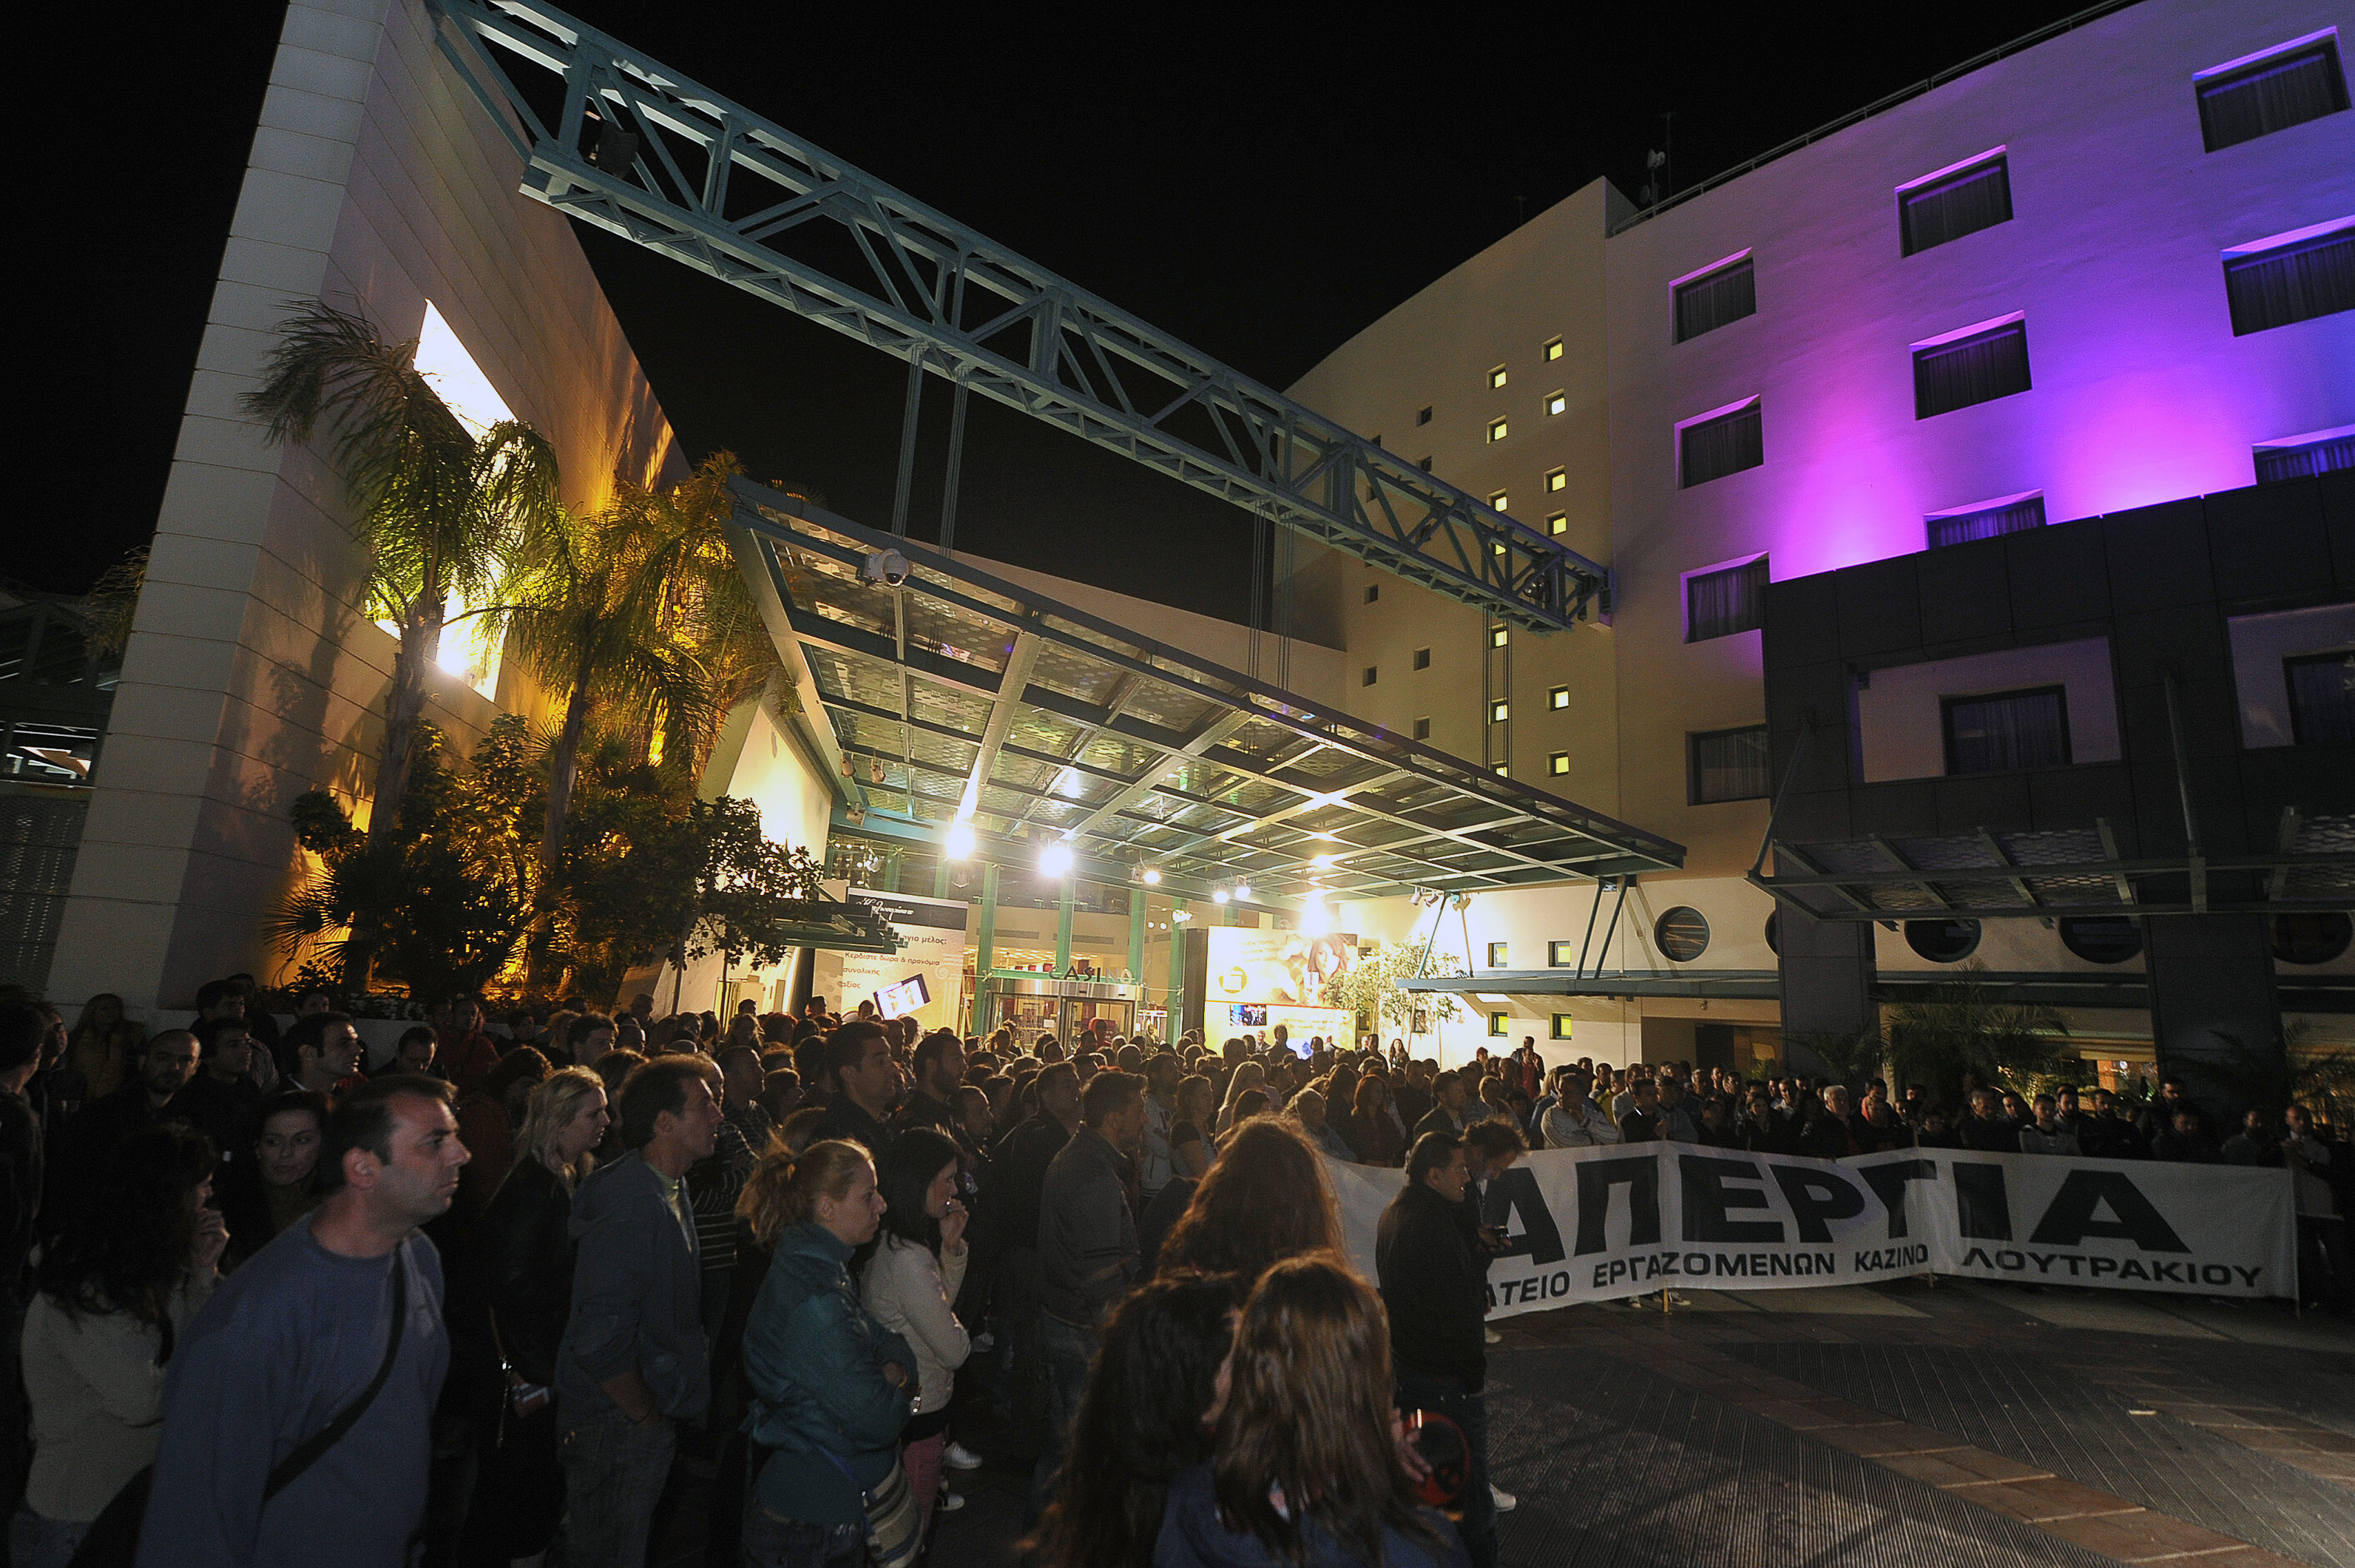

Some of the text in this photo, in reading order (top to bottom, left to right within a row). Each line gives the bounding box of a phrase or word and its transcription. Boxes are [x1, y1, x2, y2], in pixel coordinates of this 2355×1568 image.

[1049, 965, 1133, 984] CASINO
[1592, 1252, 1835, 1288] ΕΡΓΑΖΟΜΕΝΩΝ
[1854, 1244, 1929, 1272] ΚΑΖΙΝΟ
[1963, 1247, 2262, 1288] ΛΟΥΤΡΑΚΙΟΥ
